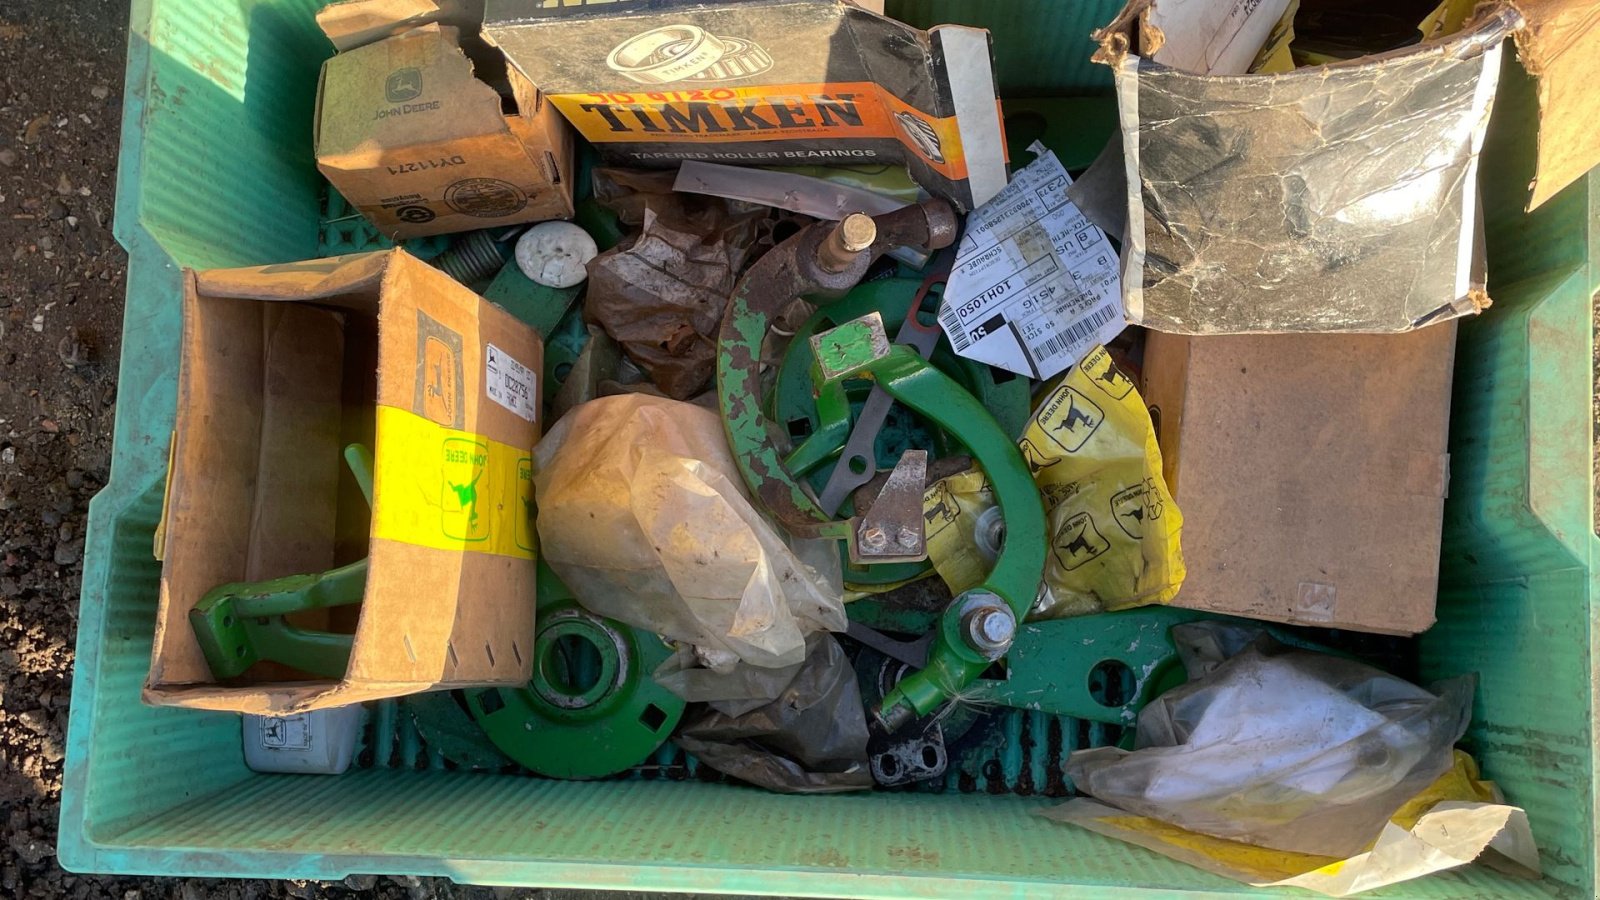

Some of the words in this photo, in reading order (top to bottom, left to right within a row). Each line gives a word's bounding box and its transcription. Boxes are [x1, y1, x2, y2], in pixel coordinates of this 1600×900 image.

[661, 51, 703, 76] TIMKEN
[373, 107, 402, 121] JOHN
[403, 100, 440, 117] DEERE
[581, 93, 864, 133] TIMKEN
[631, 151, 707, 161] TAPERED
[708, 150, 779, 160] ROLLER
[783, 149, 876, 159] BEARINGS
[386, 155, 466, 176] DY11271
[1053, 239, 1074, 256] US
[966, 245, 1002, 270] SCHRAUBE
[1095, 255, 1107, 266] B
[1071, 269, 1082, 281] 3
[956, 279, 1013, 318] 10H1050
[1082, 353, 1101, 374] DEERE
[1054, 388, 1071, 406] JOHN
[1038, 403, 1059, 425] DEERE
[445, 449, 468, 464] DEERE
[469, 453, 487, 467] JOHN
[1071, 514, 1089, 528] JOHN
